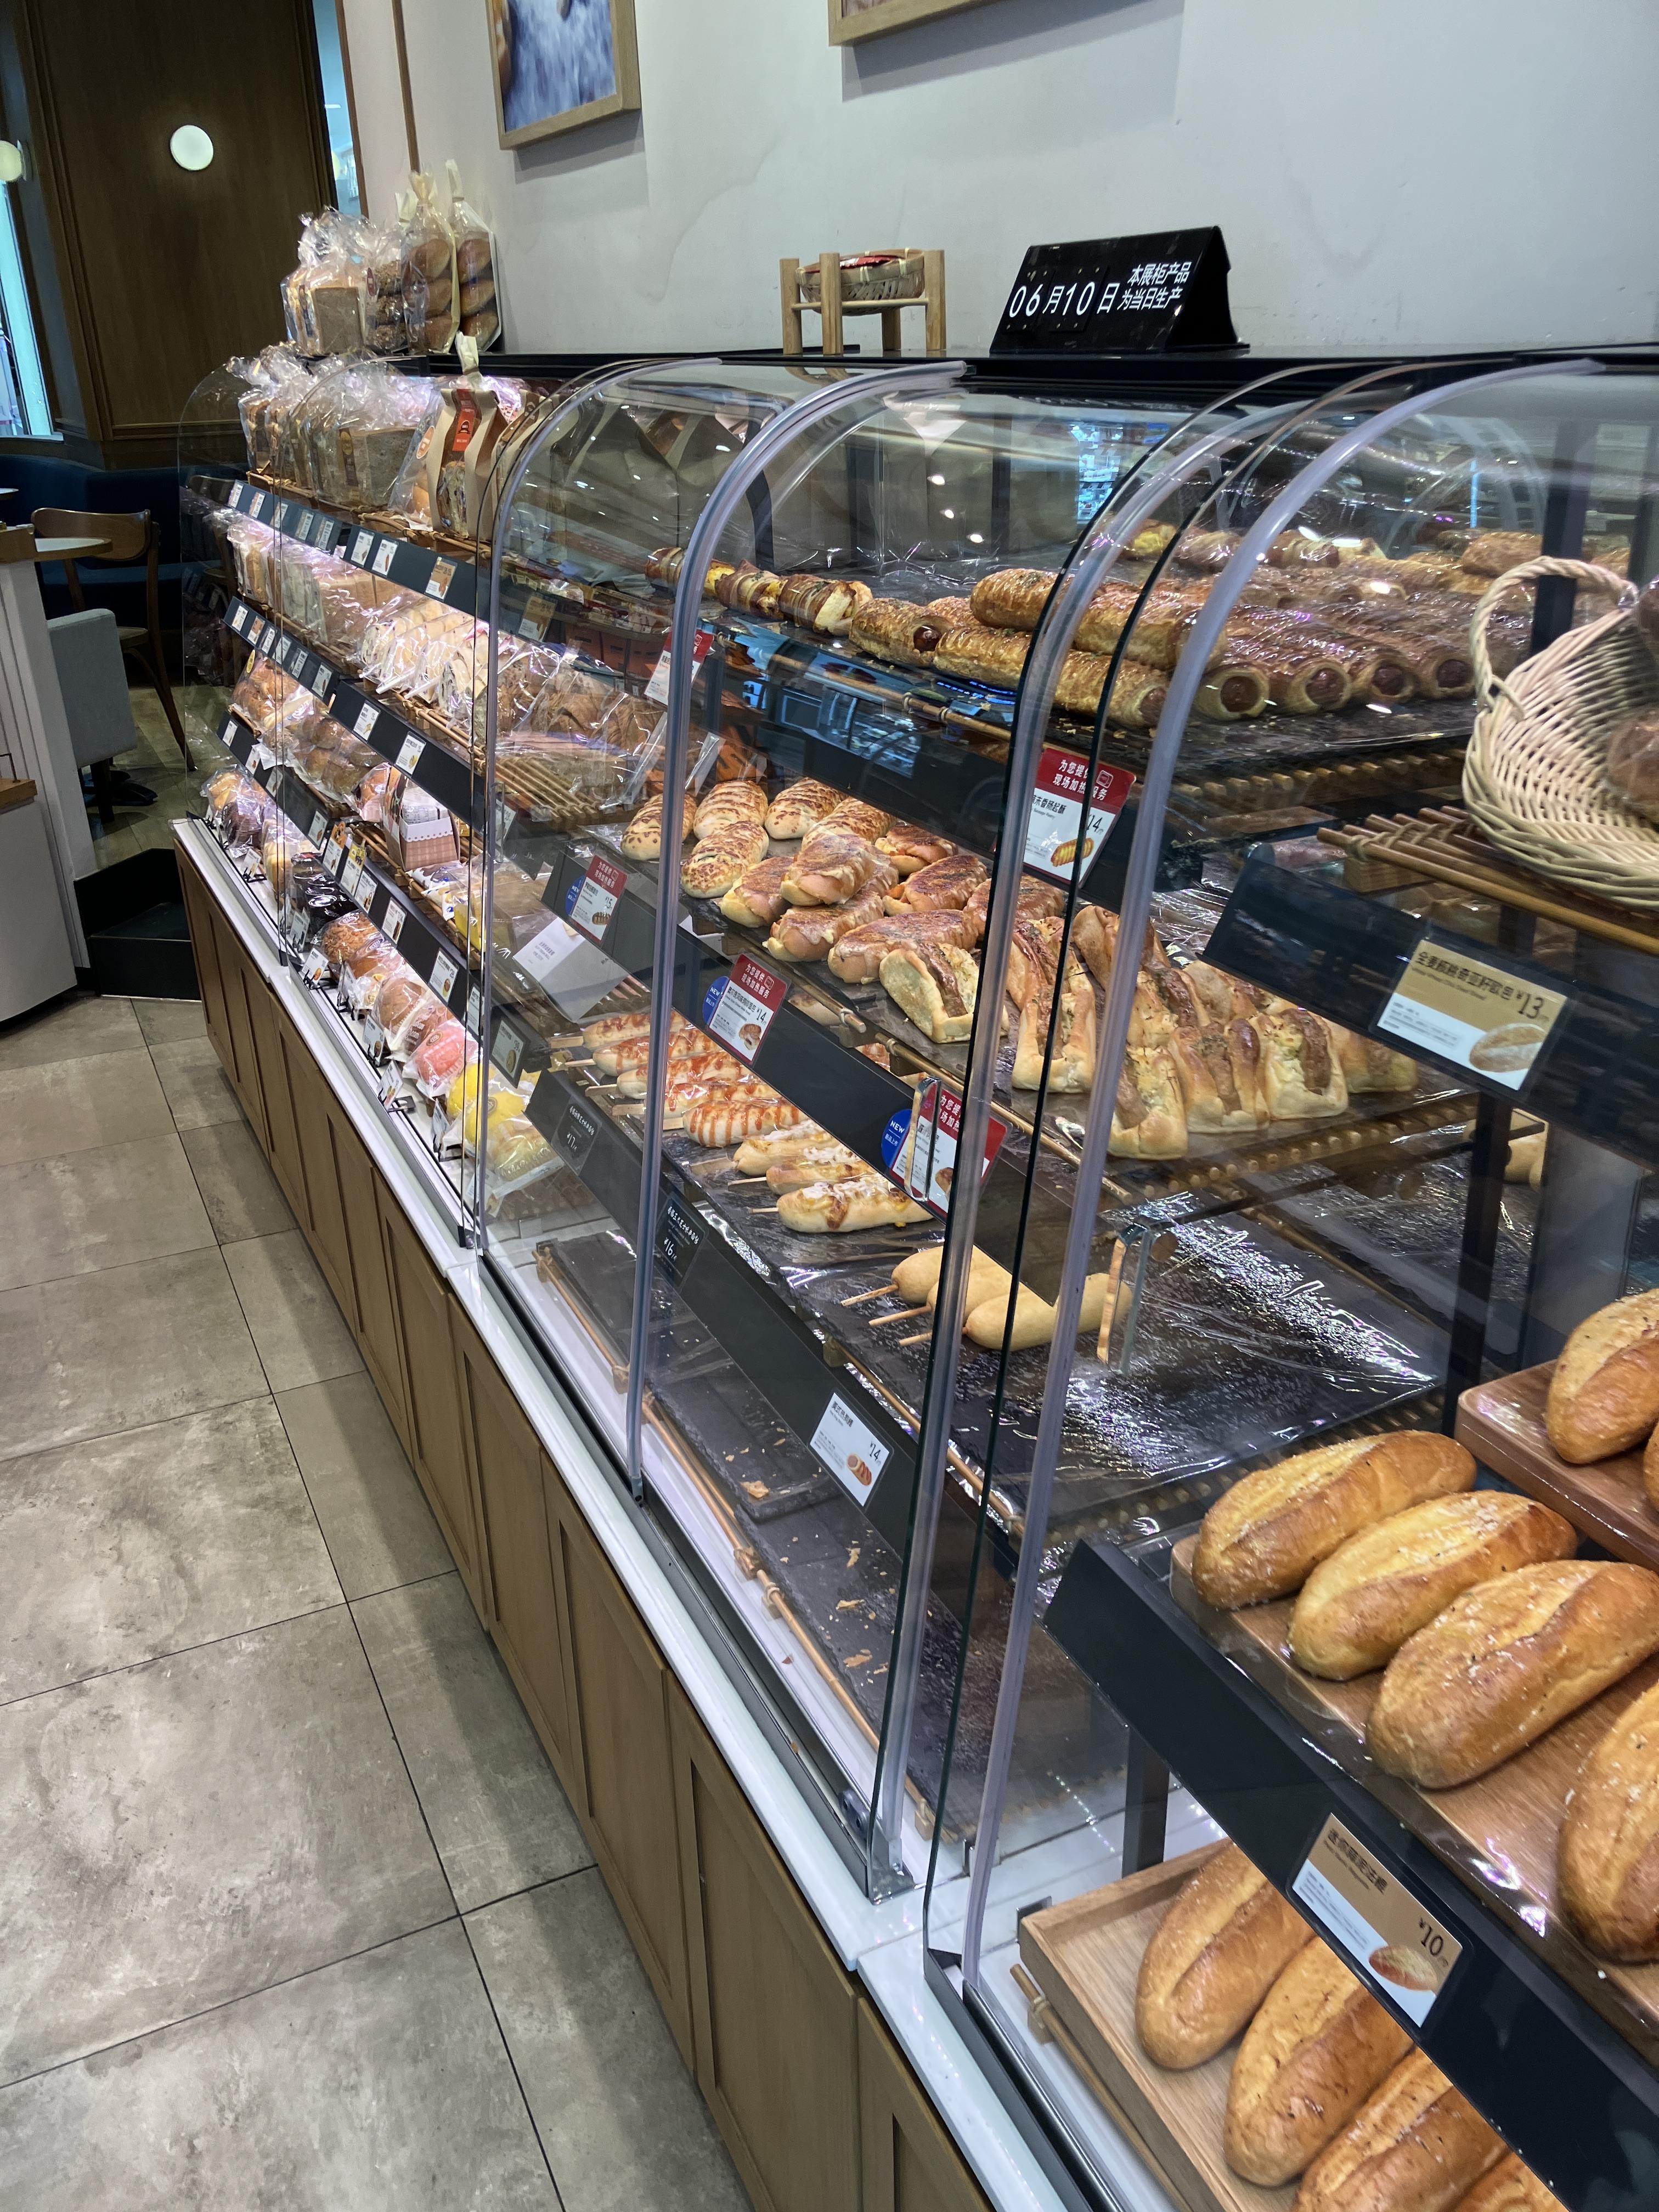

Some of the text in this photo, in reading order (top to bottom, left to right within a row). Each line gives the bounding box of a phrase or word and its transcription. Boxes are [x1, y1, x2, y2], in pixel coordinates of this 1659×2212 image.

[1127, 261, 1193, 287] 本展柜产品
[1117, 286, 1183, 311] 为当日生产
[710, 987, 720, 997] NEW
[940, 1095, 961, 1118] 为您提
[890, 1120, 905, 1133] NEW
